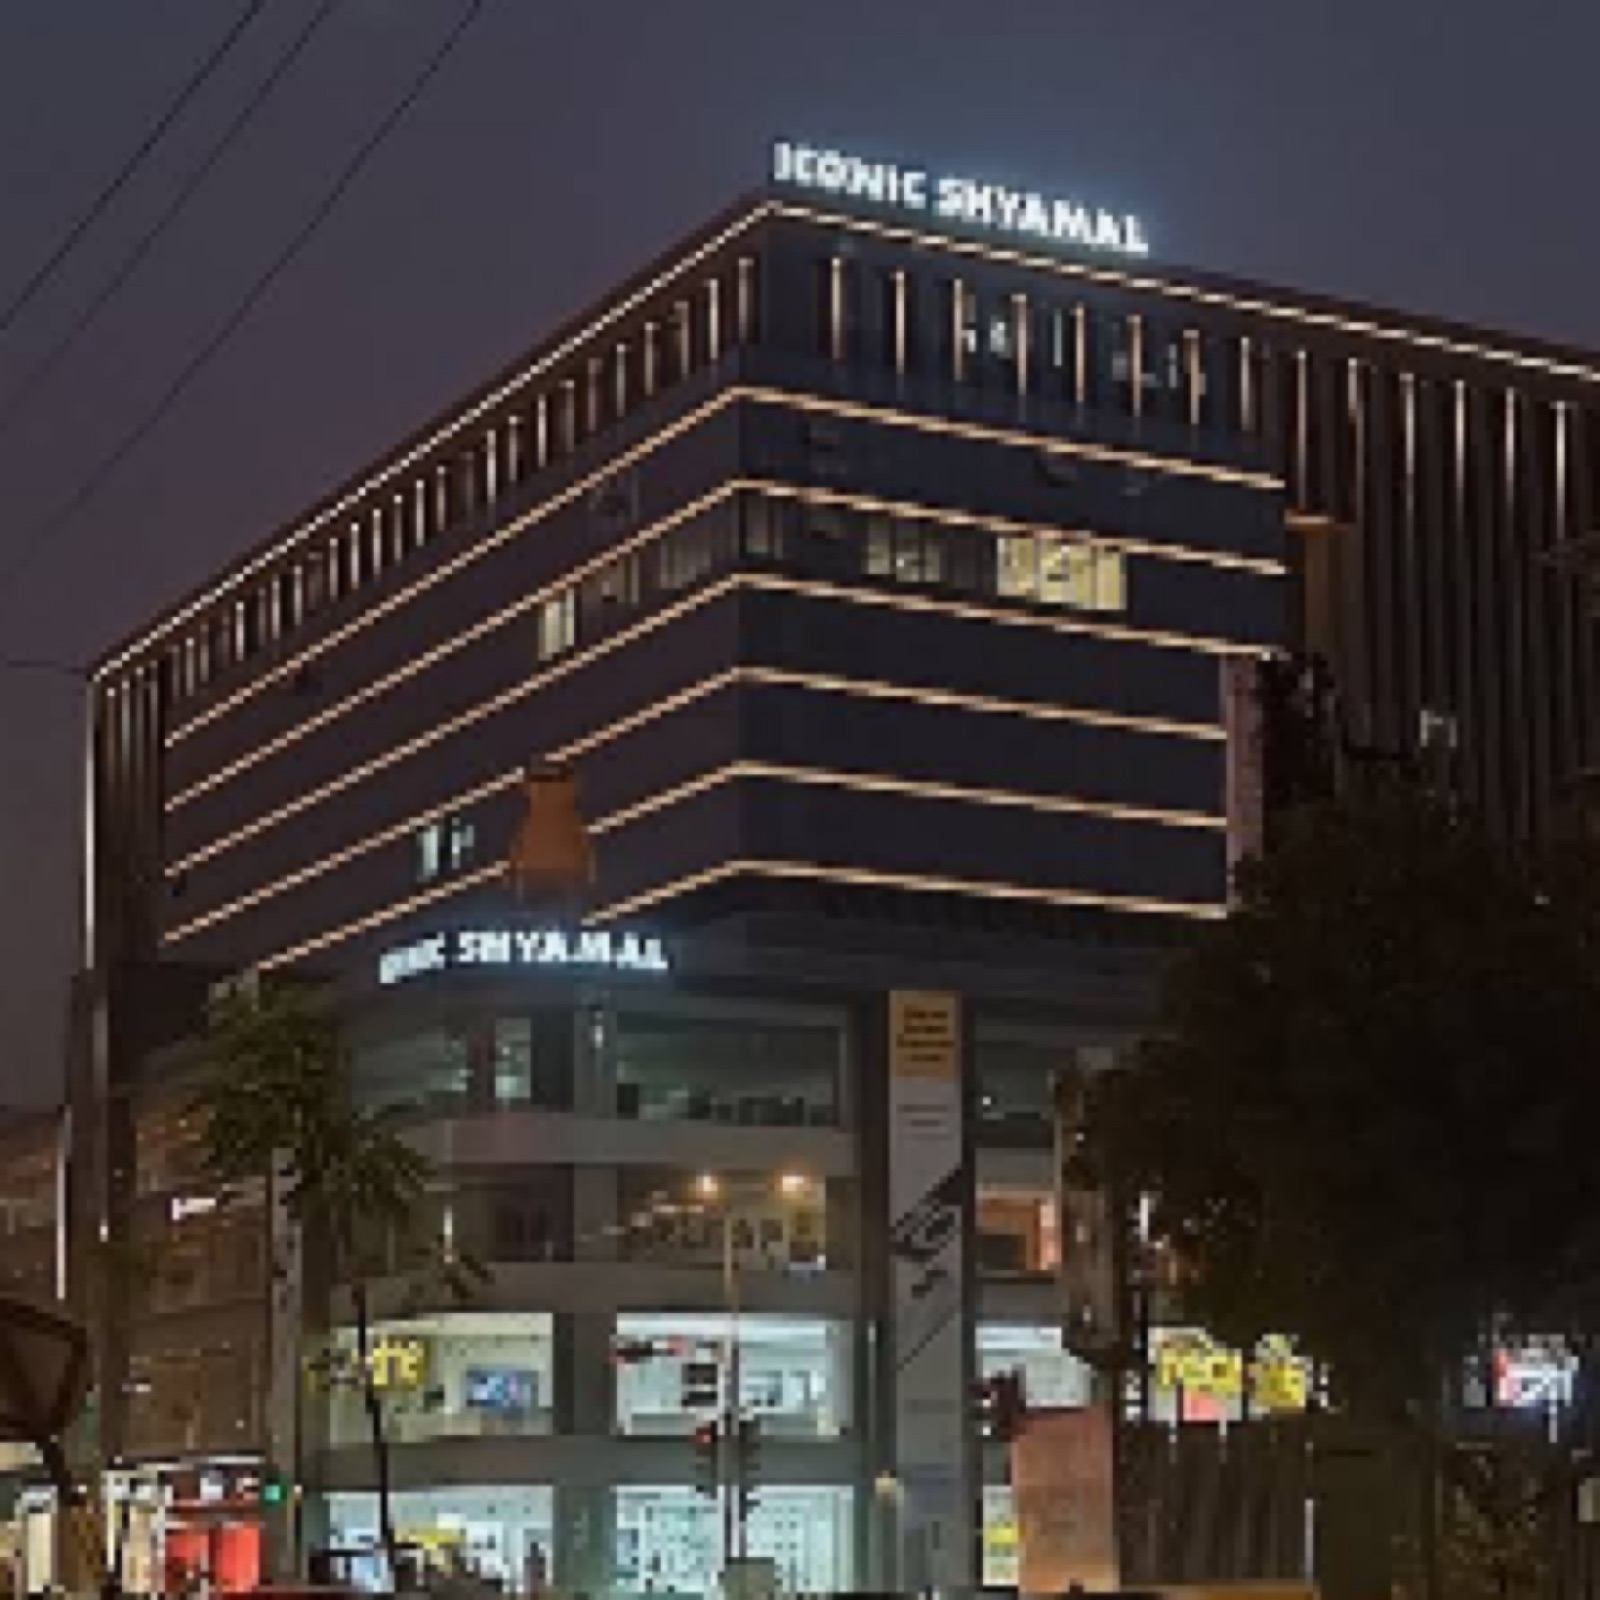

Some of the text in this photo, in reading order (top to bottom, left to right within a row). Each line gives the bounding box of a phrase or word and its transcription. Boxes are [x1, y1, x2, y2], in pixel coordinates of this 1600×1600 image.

[773, 142, 1149, 254] ICONIC SHYAMAL
[457, 930, 669, 970] SHYAMAL
